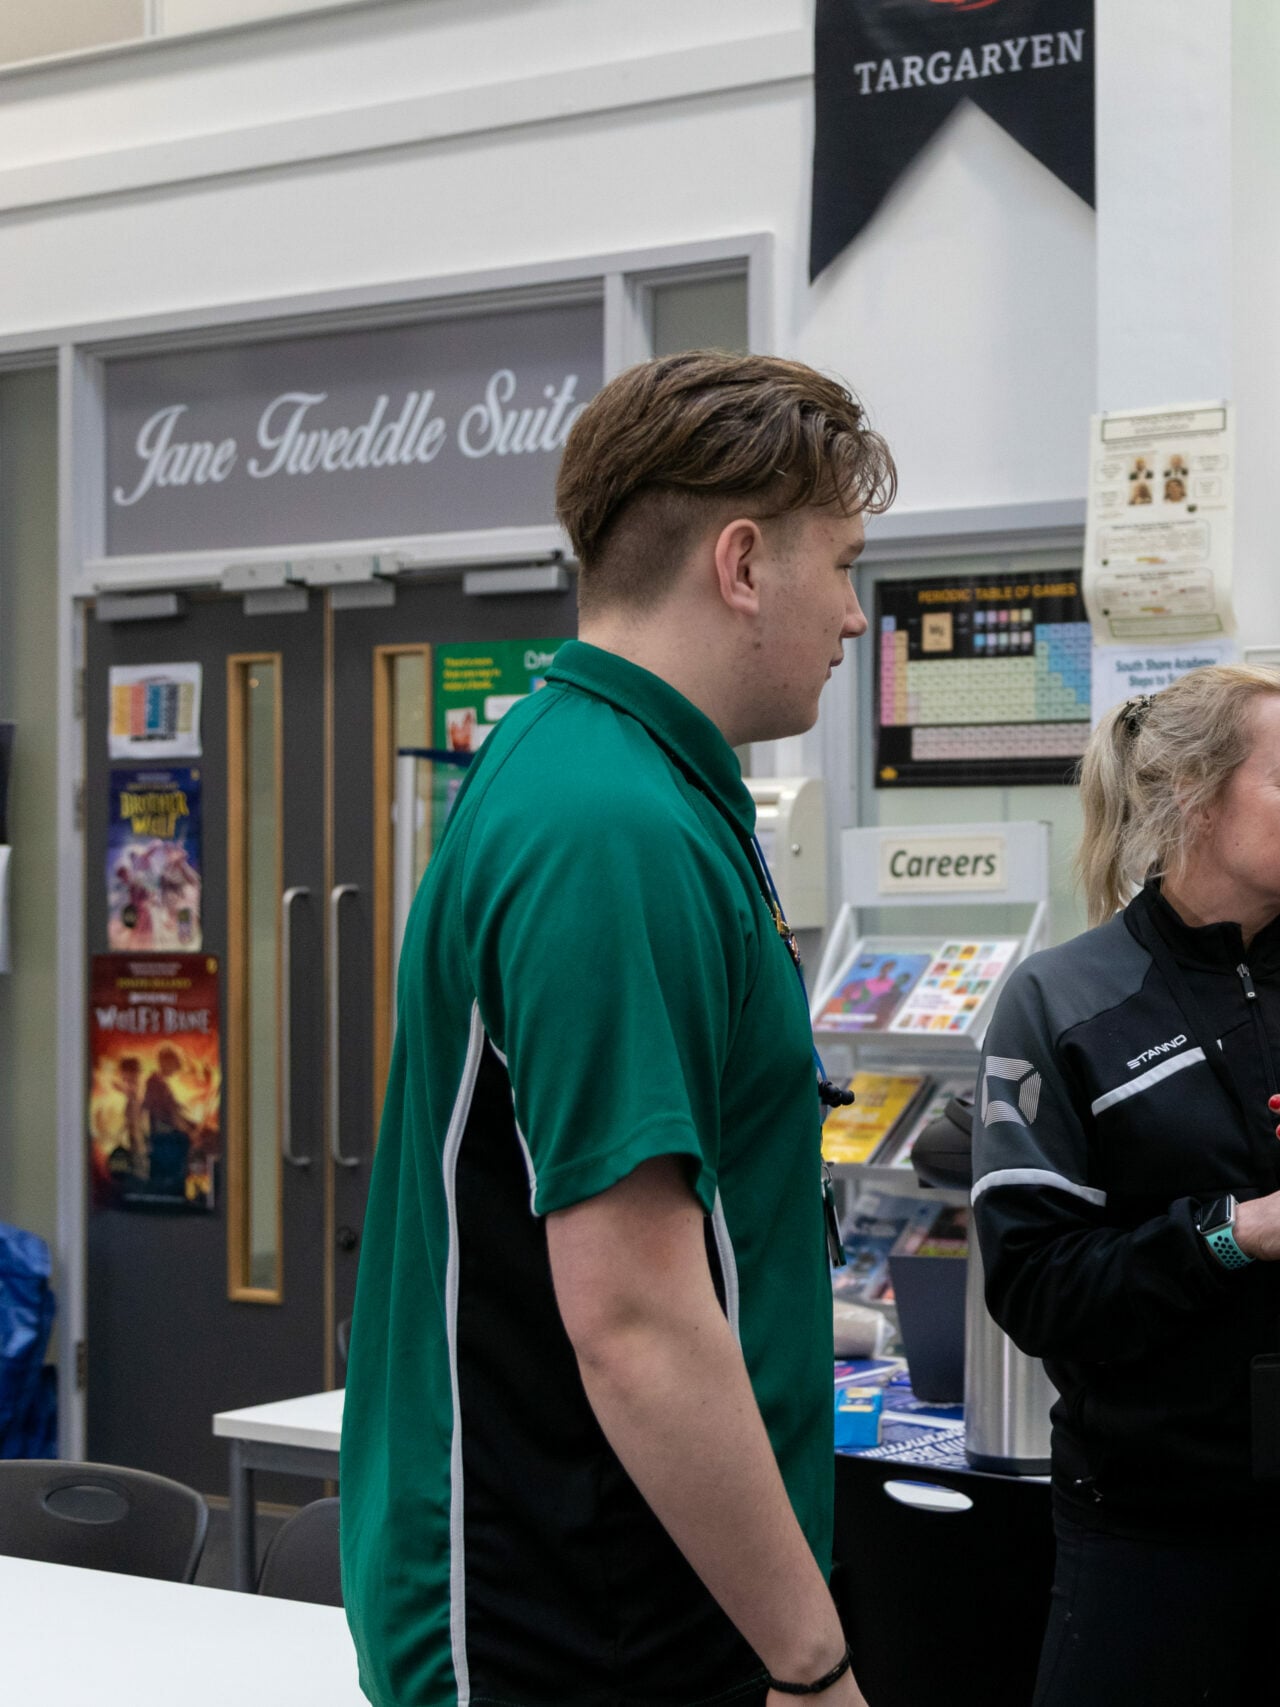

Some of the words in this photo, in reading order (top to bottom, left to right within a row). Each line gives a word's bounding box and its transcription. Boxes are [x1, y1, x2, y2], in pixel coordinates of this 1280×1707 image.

[854, 28, 1086, 95] TARGARYEN
[113, 405, 238, 506] Jane
[247, 390, 447, 479] Tweddle
[975, 586, 1013, 600] TABLE
[1015, 585, 1030, 599] OF
[1032, 582, 1077, 598] GAMES
[890, 850, 996, 878] Careers
[1126, 1034, 1187, 1069] STANNO
